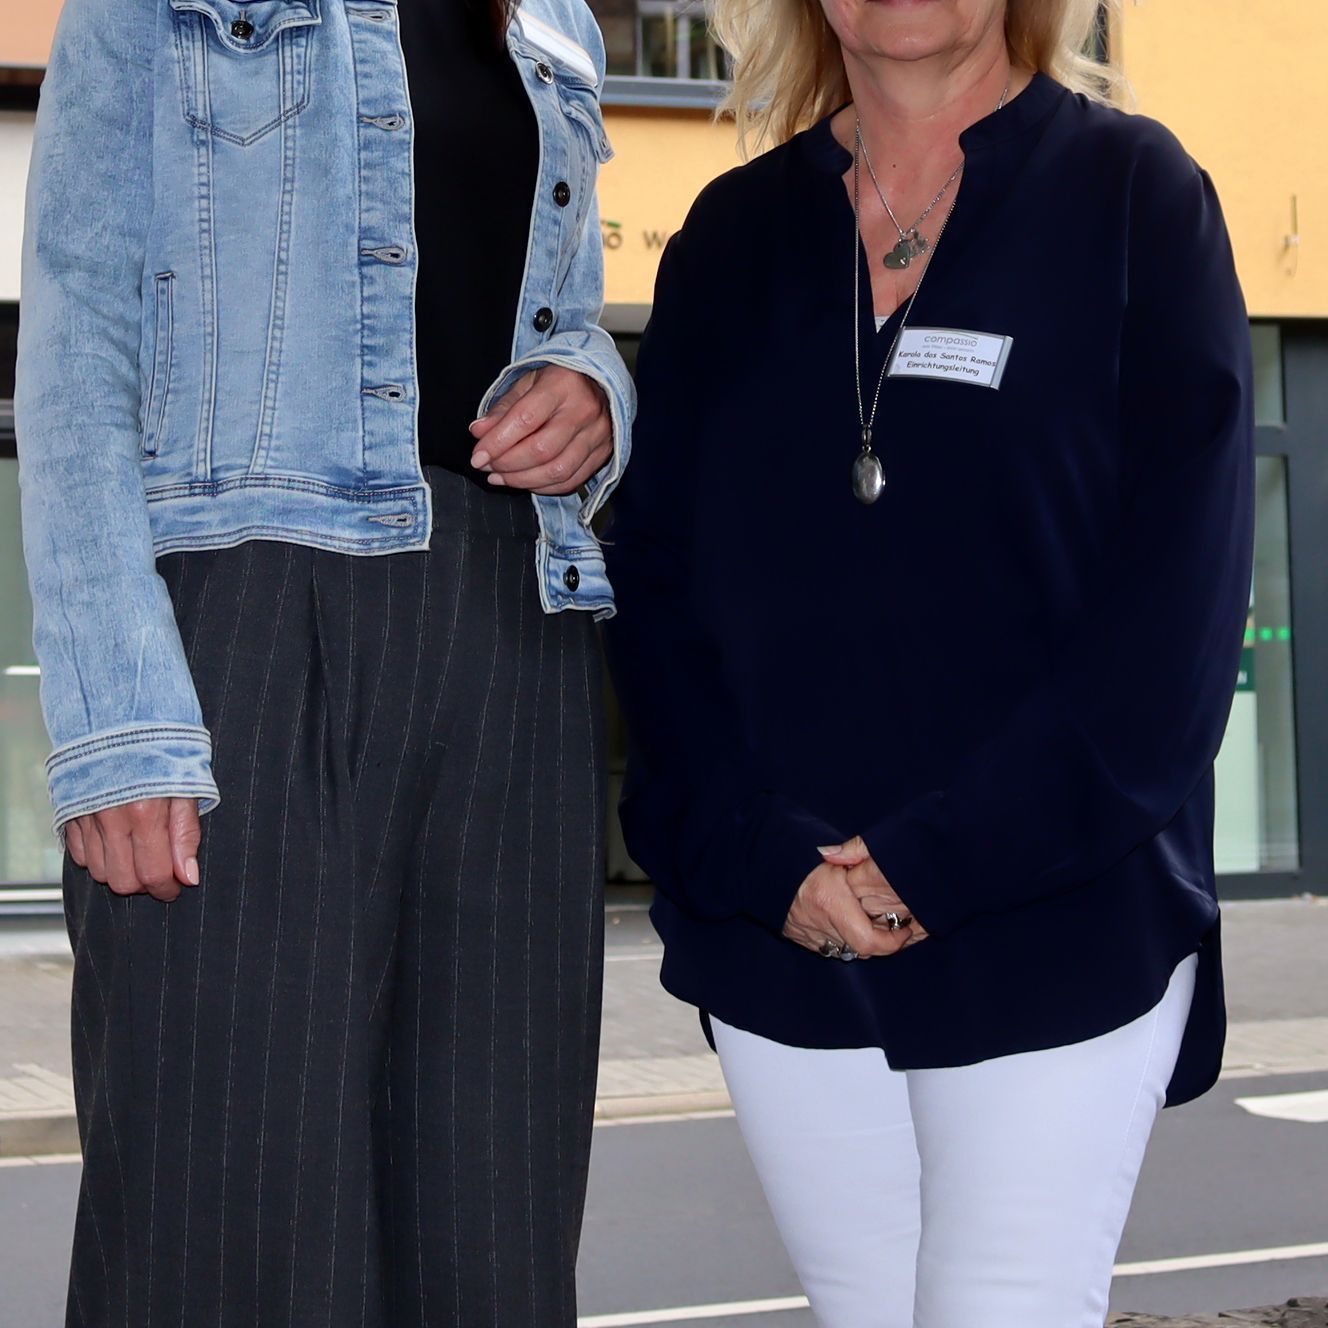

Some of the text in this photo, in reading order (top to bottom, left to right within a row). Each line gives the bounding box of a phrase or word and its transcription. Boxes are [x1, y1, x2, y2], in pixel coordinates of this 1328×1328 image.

[924, 335, 977, 347] compassio
[939, 352, 967, 361] Santos
[970, 356, 996, 366] Ramos
[906, 361, 979, 376] Einrichtungsleitung
